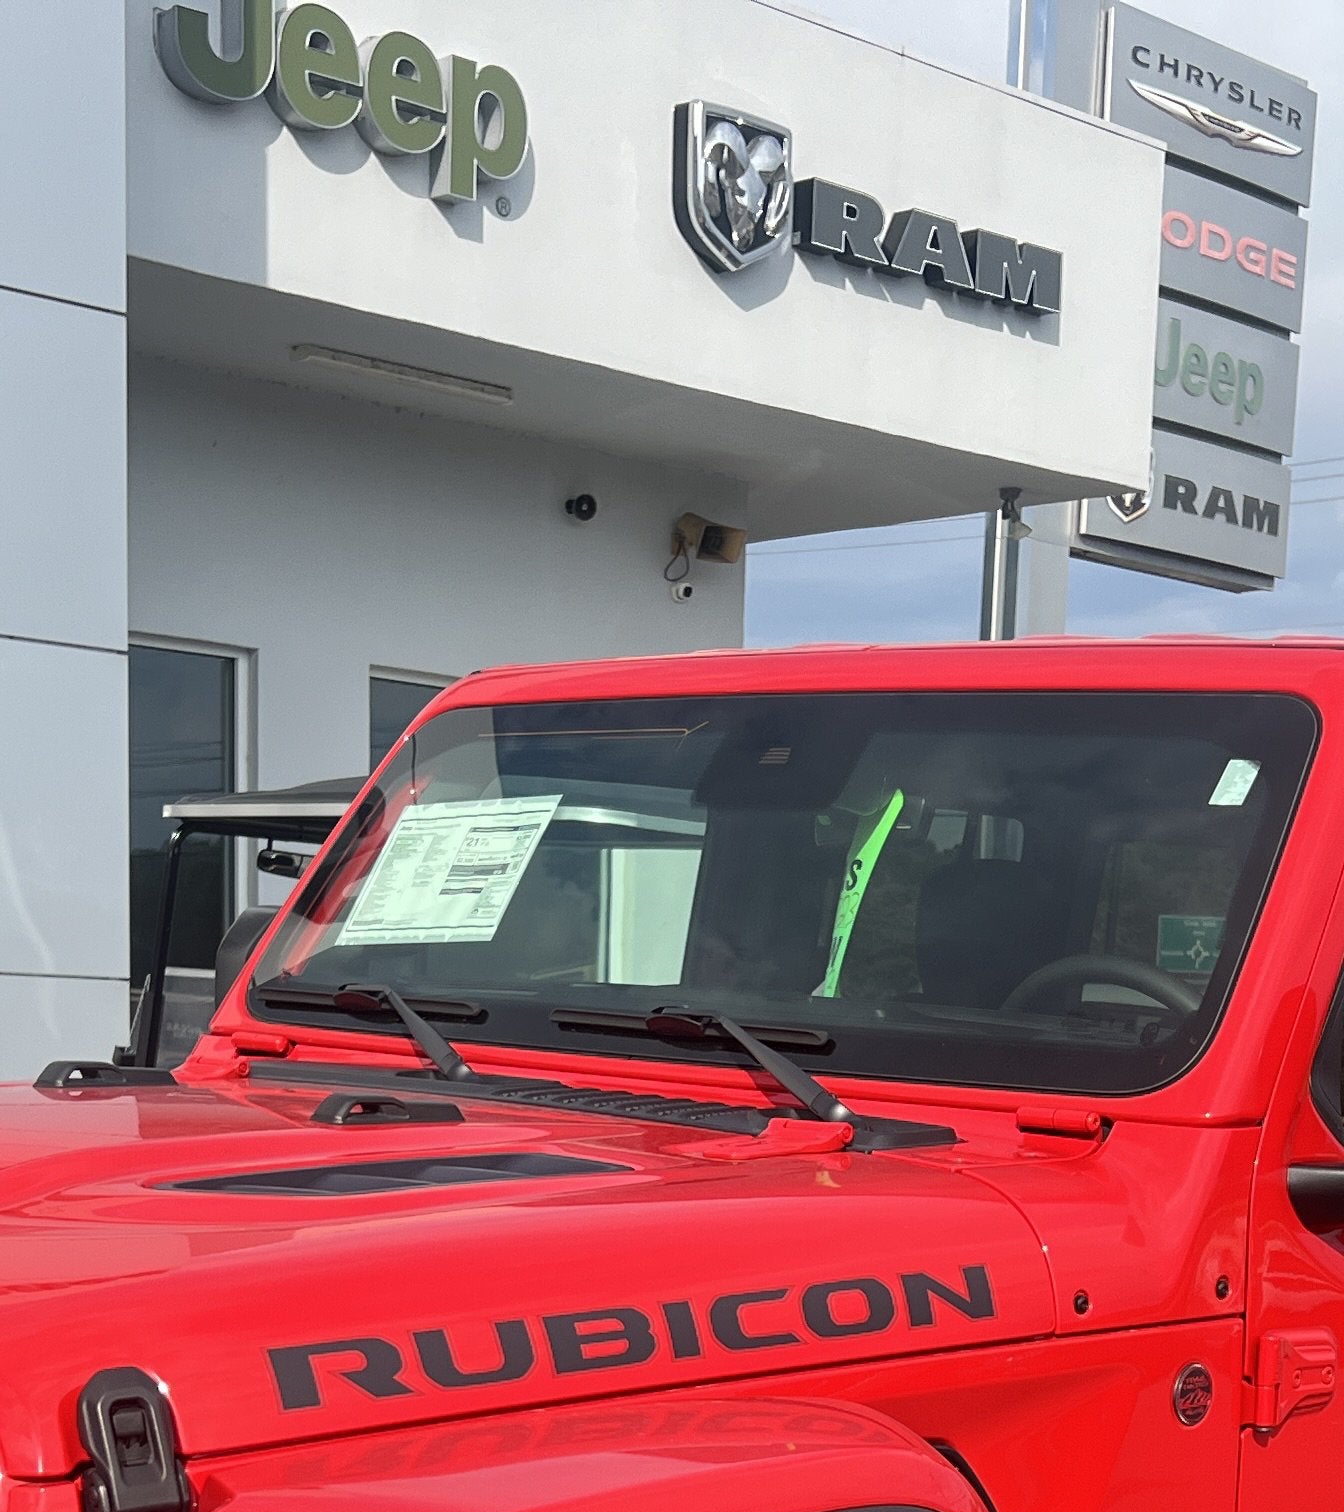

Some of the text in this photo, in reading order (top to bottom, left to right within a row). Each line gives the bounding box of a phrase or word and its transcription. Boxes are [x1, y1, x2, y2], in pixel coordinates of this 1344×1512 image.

[155, 0, 528, 203] Jeep
[1131, 45, 1303, 131] CHRYSLER
[796, 178, 1064, 315] RAM
[1162, 210, 1297, 289] ODGE
[1154, 317, 1265, 425] Jeep
[1162, 474, 1281, 537] RAM
[266, 1263, 998, 1413] RUBICON
